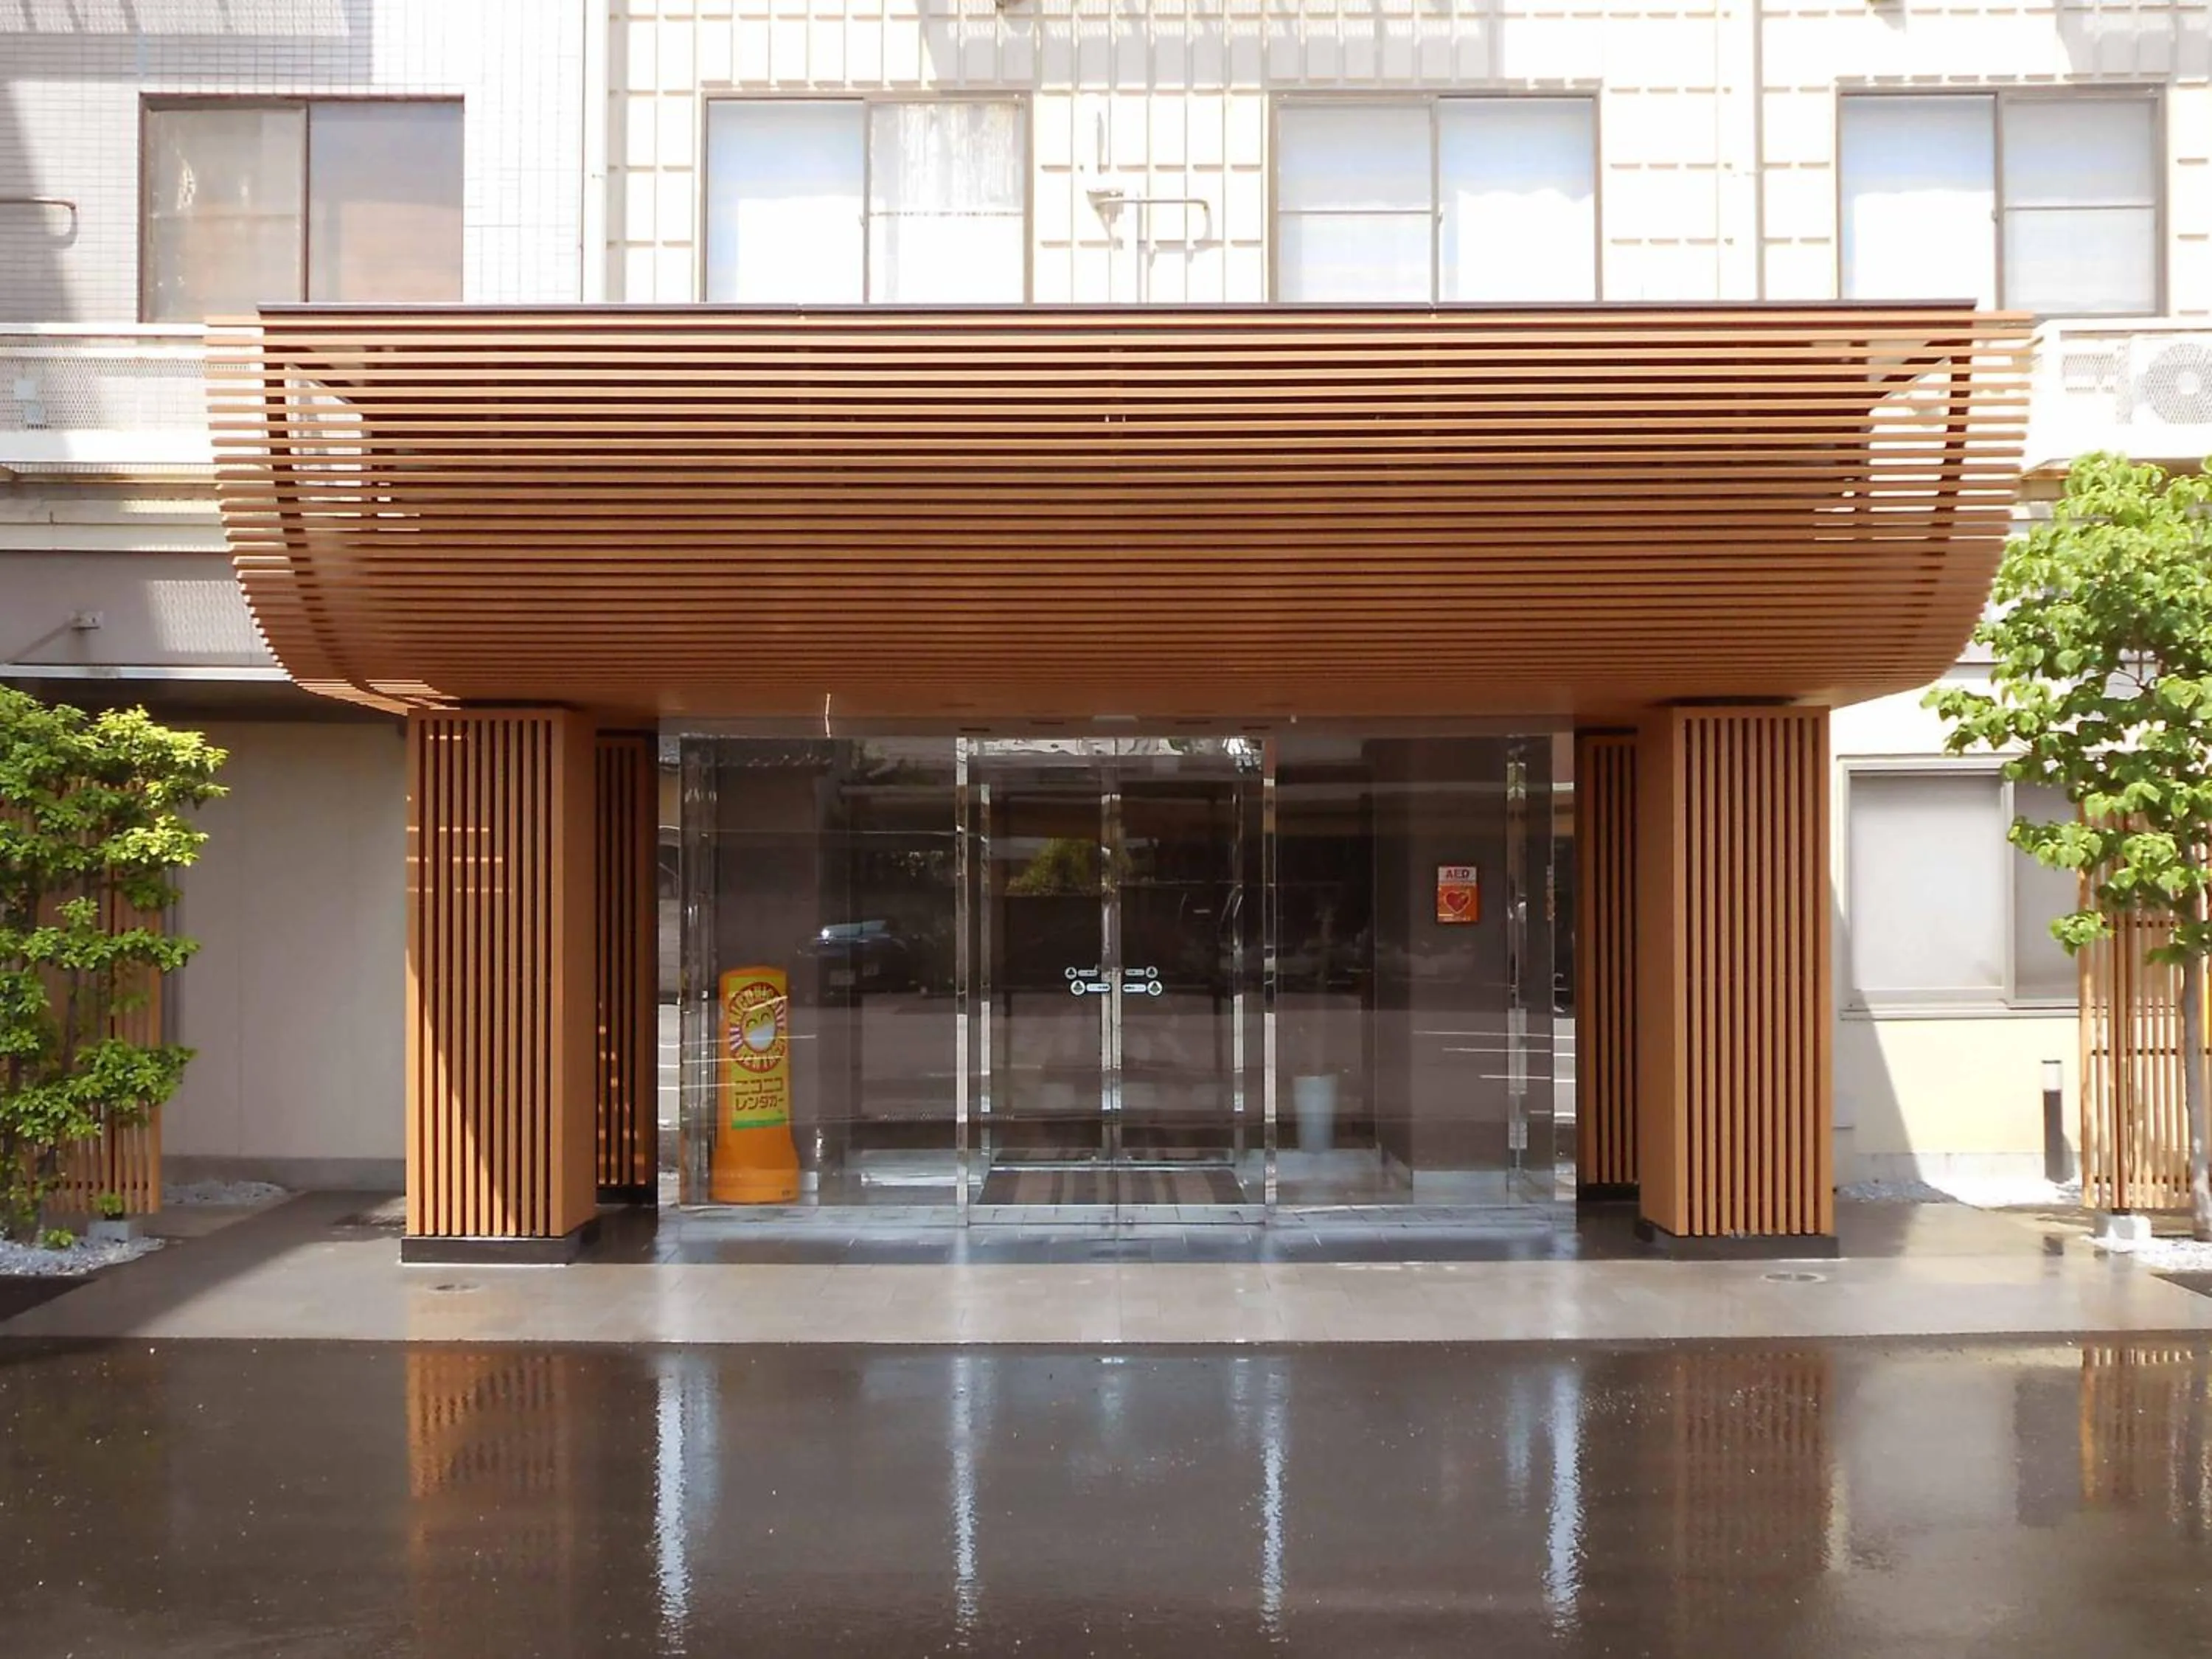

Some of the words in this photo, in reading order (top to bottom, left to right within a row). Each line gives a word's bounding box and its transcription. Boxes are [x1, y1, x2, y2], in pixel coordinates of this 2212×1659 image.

[1446, 869, 1470, 879] AED
[735, 1077, 783, 1095] ニコニコ
[736, 1095, 784, 1110] レンタカー
